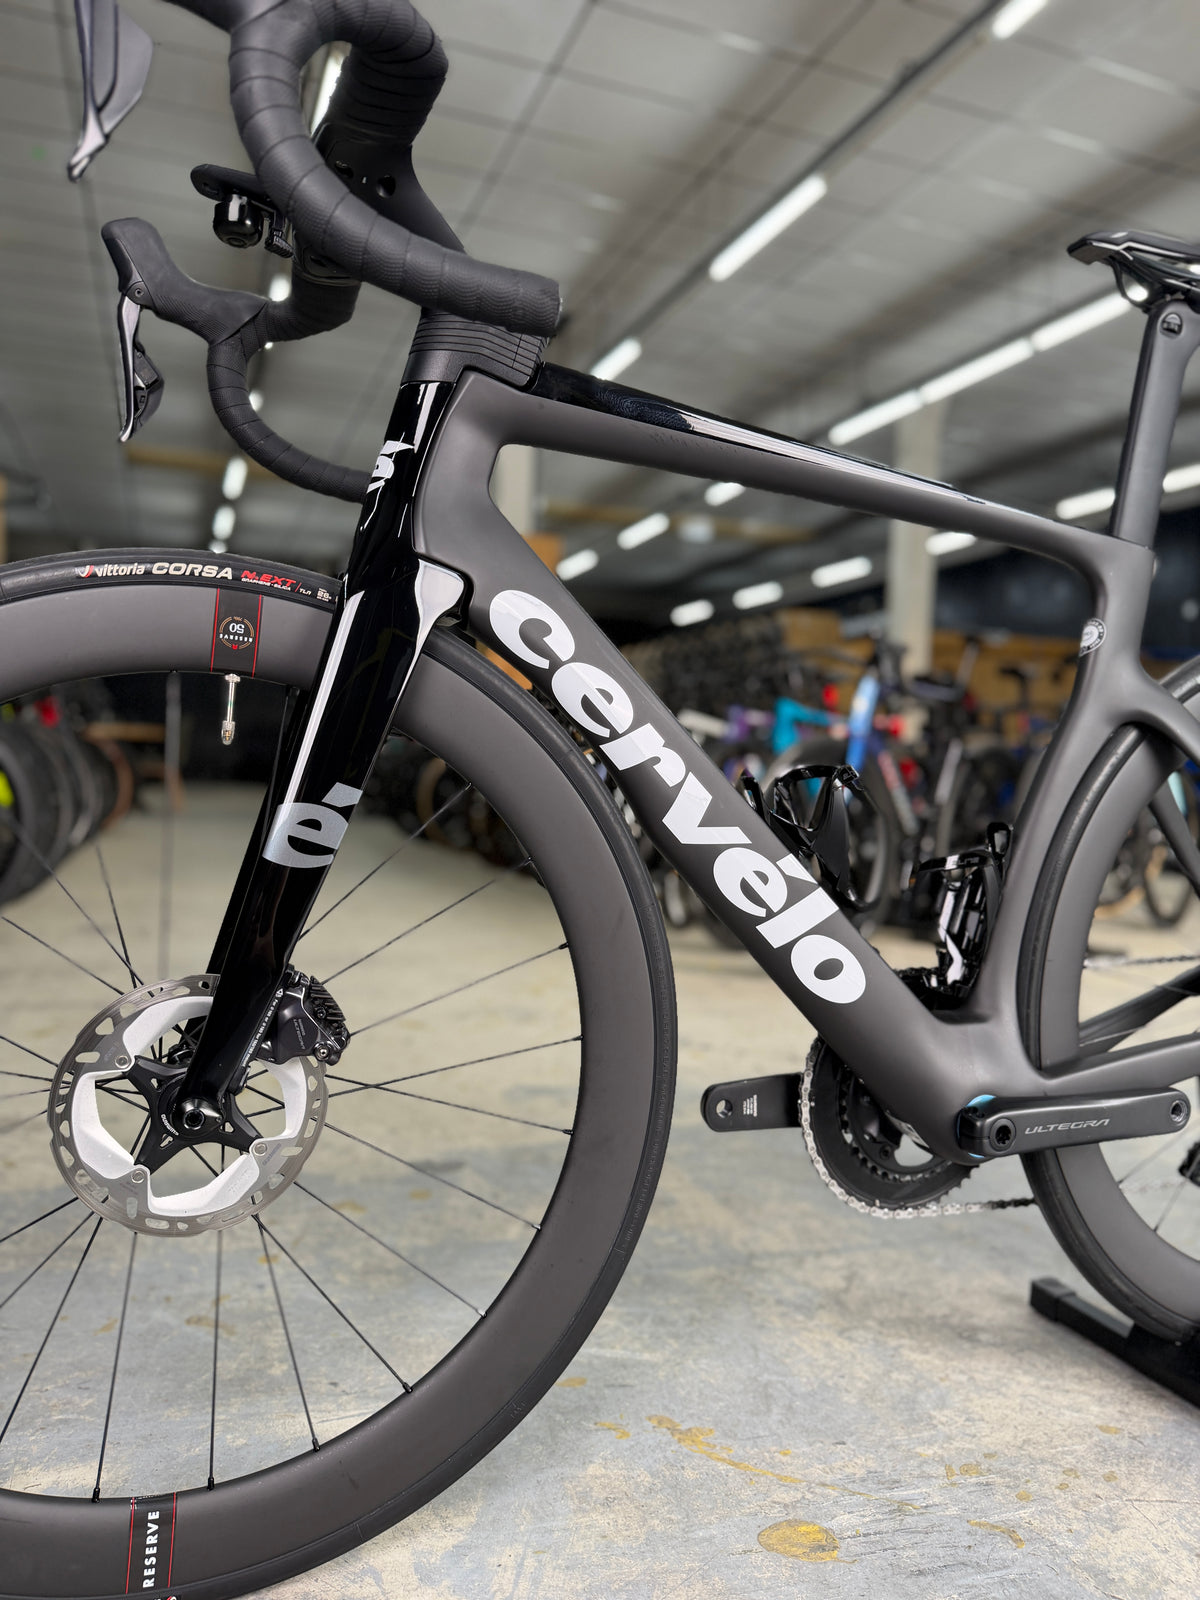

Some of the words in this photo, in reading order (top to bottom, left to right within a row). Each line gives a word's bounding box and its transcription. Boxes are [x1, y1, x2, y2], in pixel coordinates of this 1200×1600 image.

[95, 562, 145, 577] vittoria
[152, 562, 233, 580] CORSA
[229, 622, 245, 634] 50
[219, 633, 253, 643] RESERVE
[489, 589, 866, 1004] cervélo
[1024, 1118, 1111, 1135] ULTEGRA
[142, 1510, 160, 1588] RESERVE
